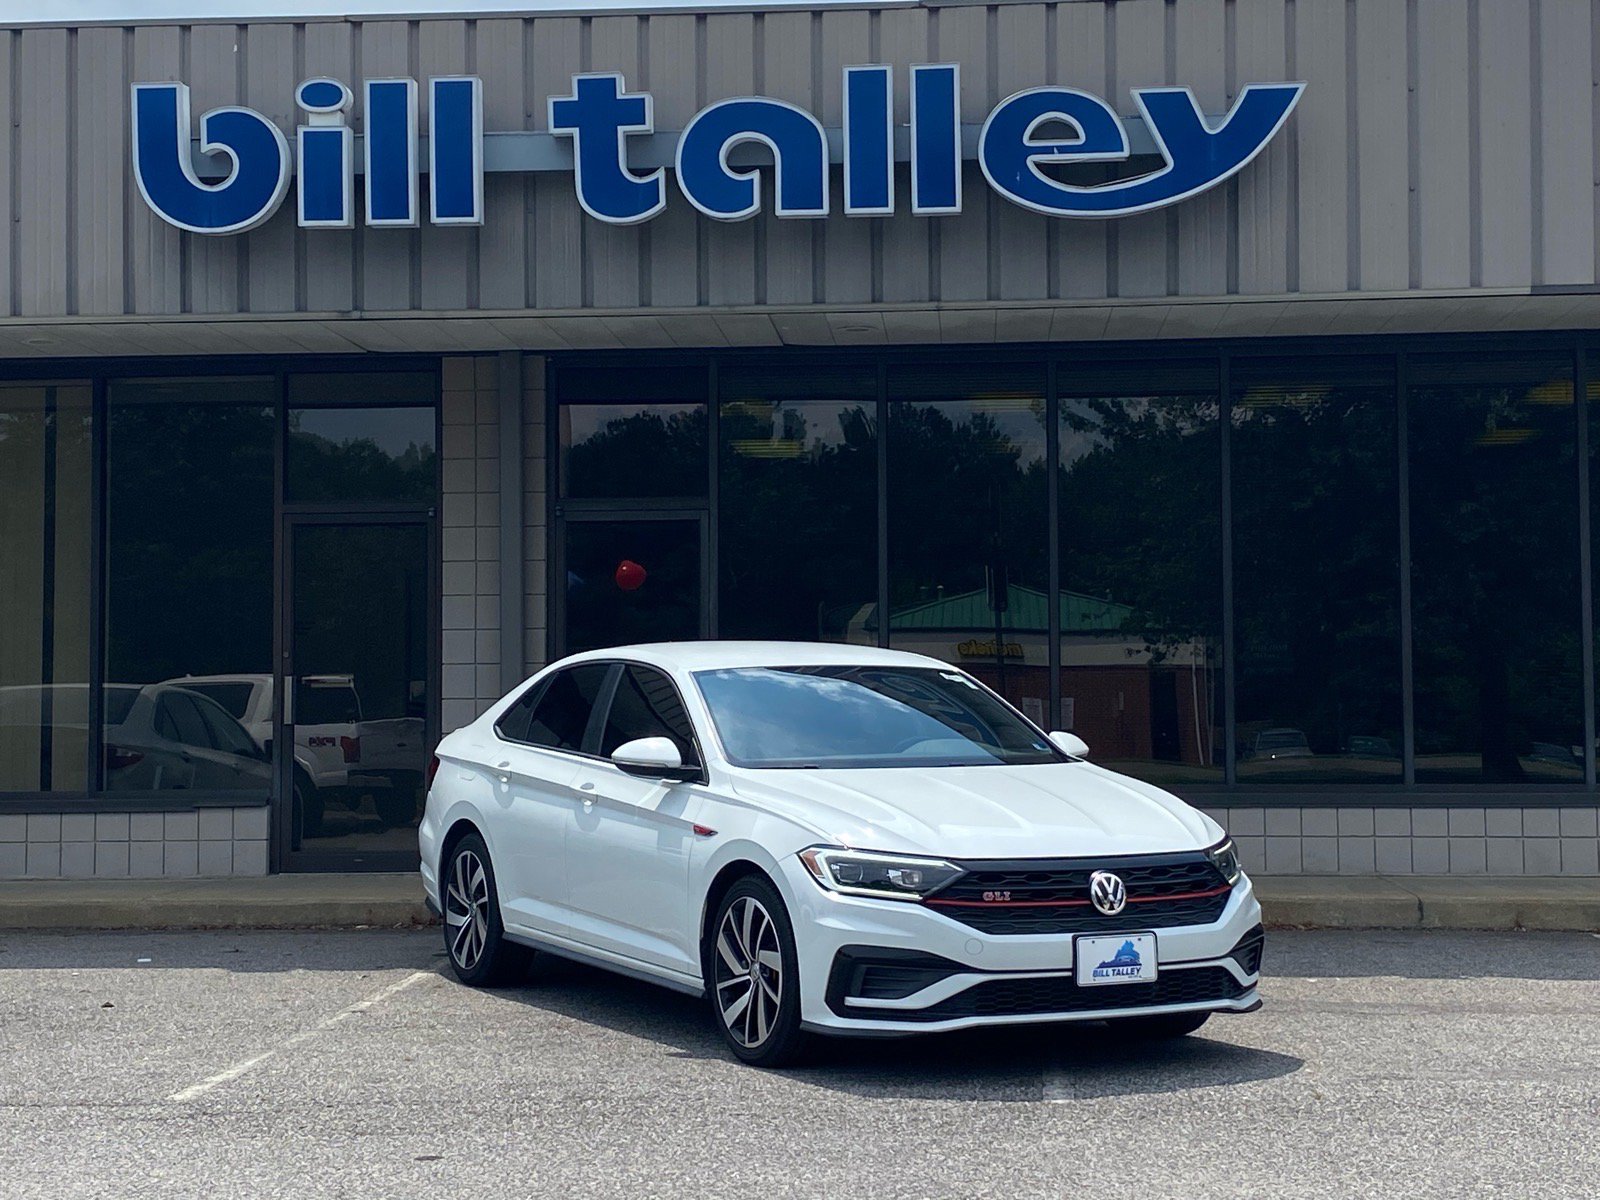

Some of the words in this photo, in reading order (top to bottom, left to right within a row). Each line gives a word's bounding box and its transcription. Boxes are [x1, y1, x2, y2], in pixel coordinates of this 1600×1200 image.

[131, 75, 484, 235] bill
[547, 63, 1307, 225] talley
[982, 891, 1012, 902] GLI
[1092, 969, 1110, 978] BILL
[1112, 967, 1142, 977] TALLEY
